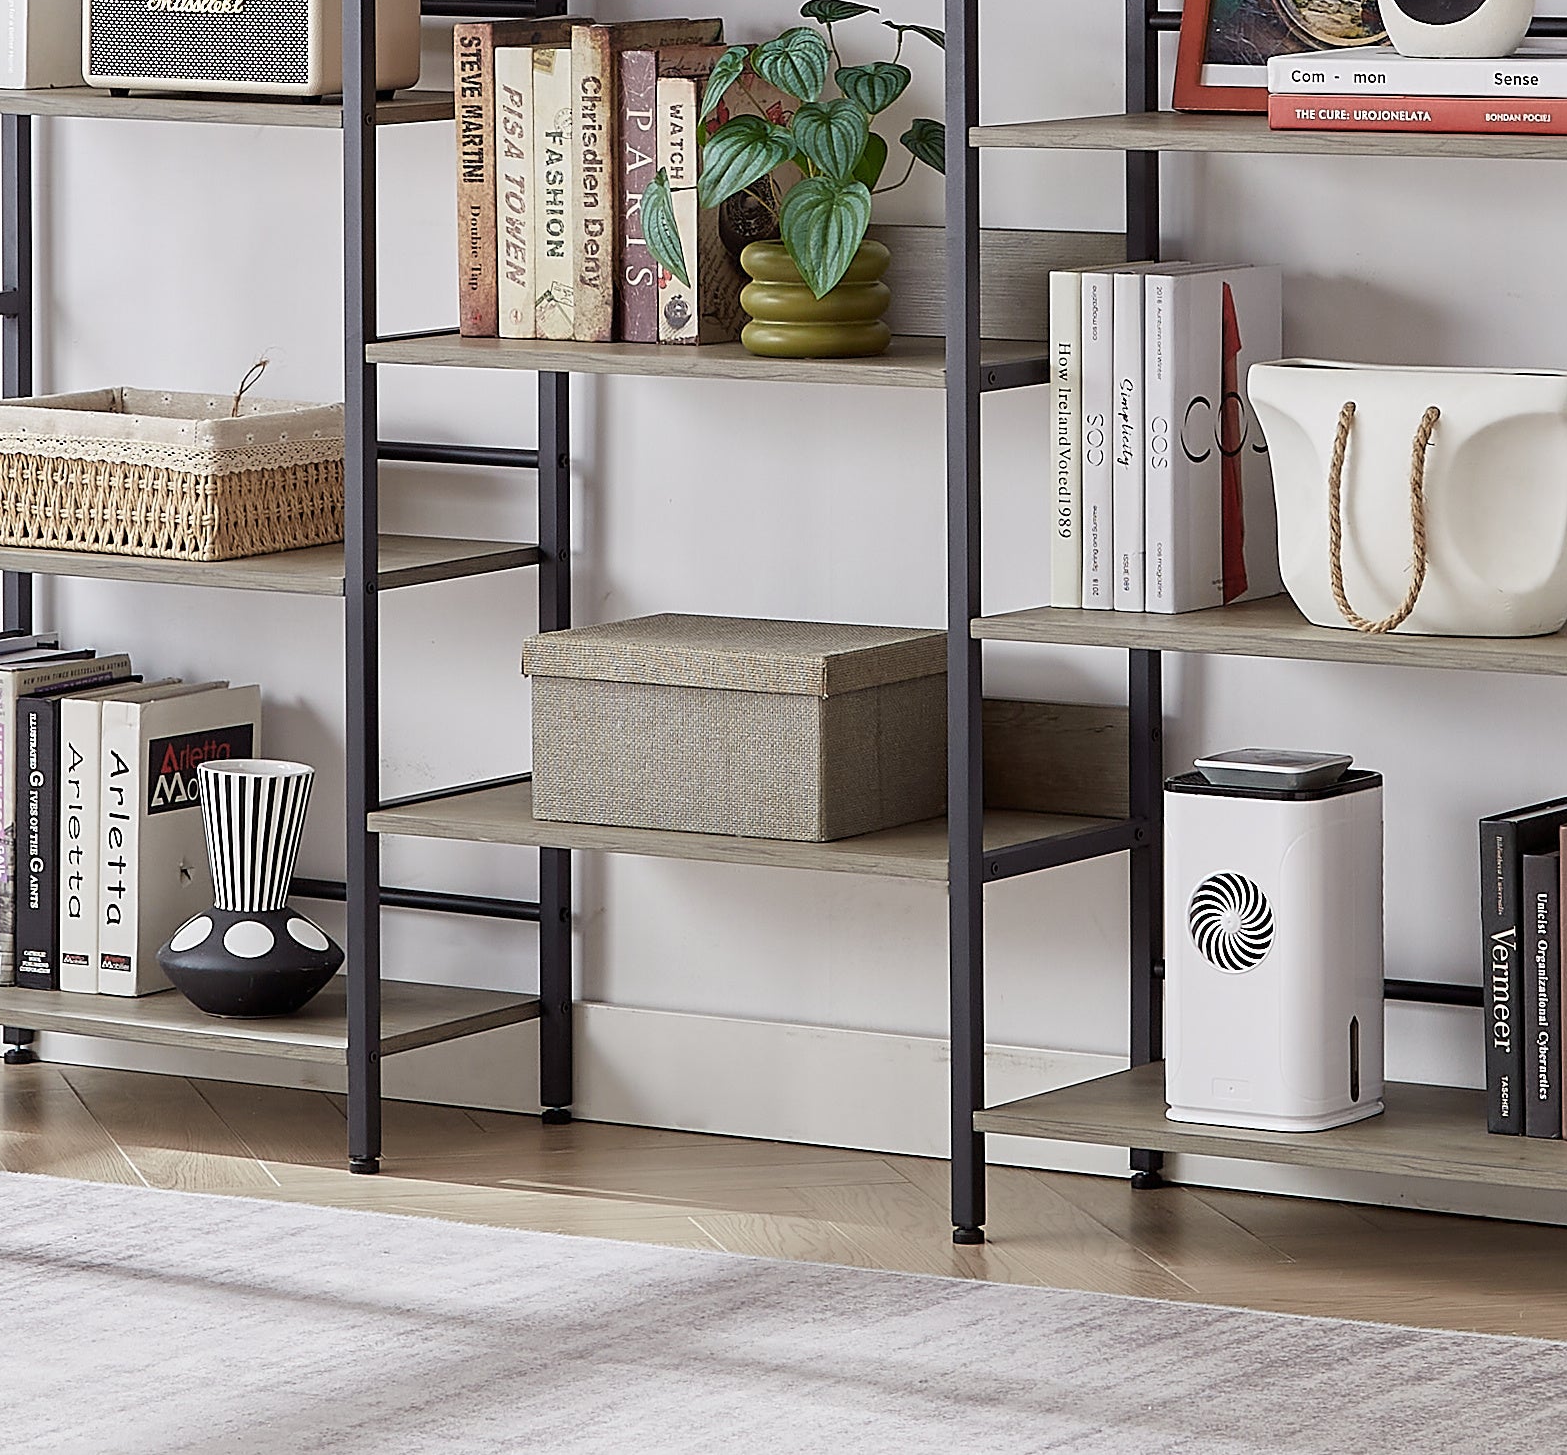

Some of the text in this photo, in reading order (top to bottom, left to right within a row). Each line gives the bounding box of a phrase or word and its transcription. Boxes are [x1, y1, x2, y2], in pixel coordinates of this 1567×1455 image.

[1291, 70, 1325, 83] Com
[1353, 72, 1386, 84] mon
[1494, 72, 1539, 86] Sense
[460, 36, 484, 183] STEVE MARTINI
[1295, 109, 1431, 122] THE CURE: UROJONELATA
[1485, 113, 1521, 122] BOHDAN
[669, 104, 683, 180] WATCH
[502, 84, 526, 288] PISA TOWEN
[545, 131, 564, 258] FASHION
[579, 75, 604, 291] Chrisdien Deny
[1058, 343, 1071, 381] How
[1087, 413, 1104, 466] COS
[1117, 378, 1133, 471] Simplicity
[1151, 416, 1168, 469] COS
[1180, 392, 1268, 464] CO
[23, 676, 35, 685] NEW
[37, 674, 50, 683] YORK
[52, 671, 69, 680] TIMES
[70, 665, 106, 677] BESTSELLING
[29, 712, 37, 770] ILLUSTRATED
[161, 740, 231, 774] Arletta
[29, 817, 38, 832] OF
[29, 833, 39, 856] THE
[69, 742, 83, 917] Arletta
[106, 749, 130, 925] Arletta
[1490, 925, 1517, 1053] Vermeer
[1536, 893, 1549, 1100] Unicist Organizational Cybernetics
[1501, 1075, 1509, 1117] TASCHEN
